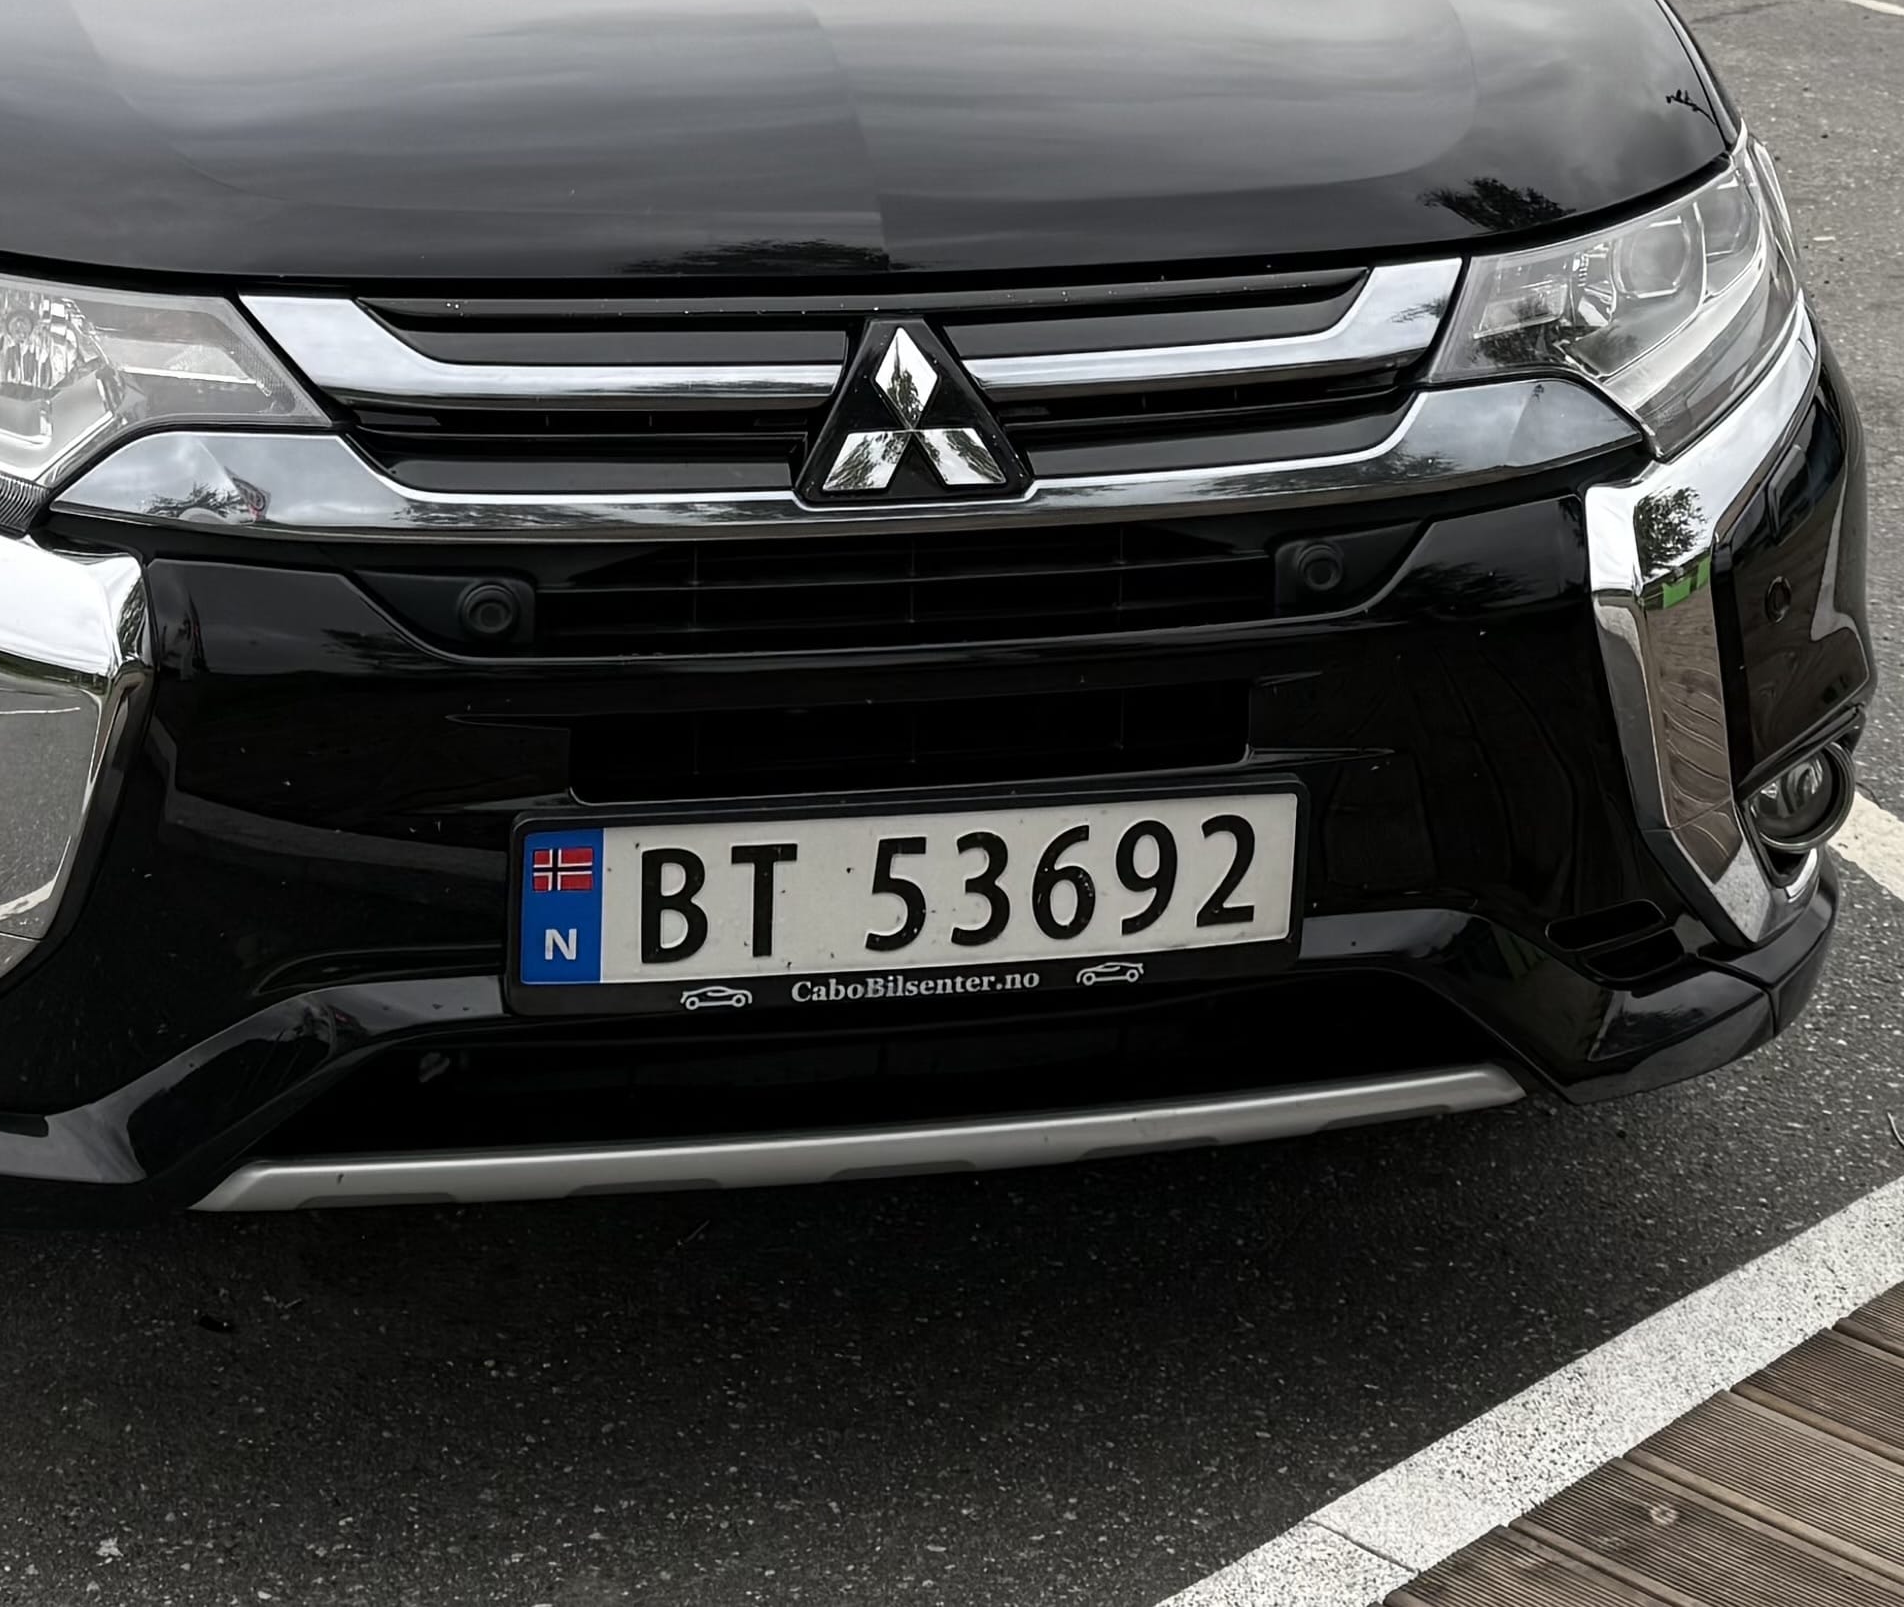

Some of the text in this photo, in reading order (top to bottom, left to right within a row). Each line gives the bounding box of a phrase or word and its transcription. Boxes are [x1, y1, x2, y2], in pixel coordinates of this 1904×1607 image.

[640, 814, 1256, 965] BT 53692
[544, 927, 578, 961] N
[791, 970, 1041, 1003] CaboBilsenter.no
